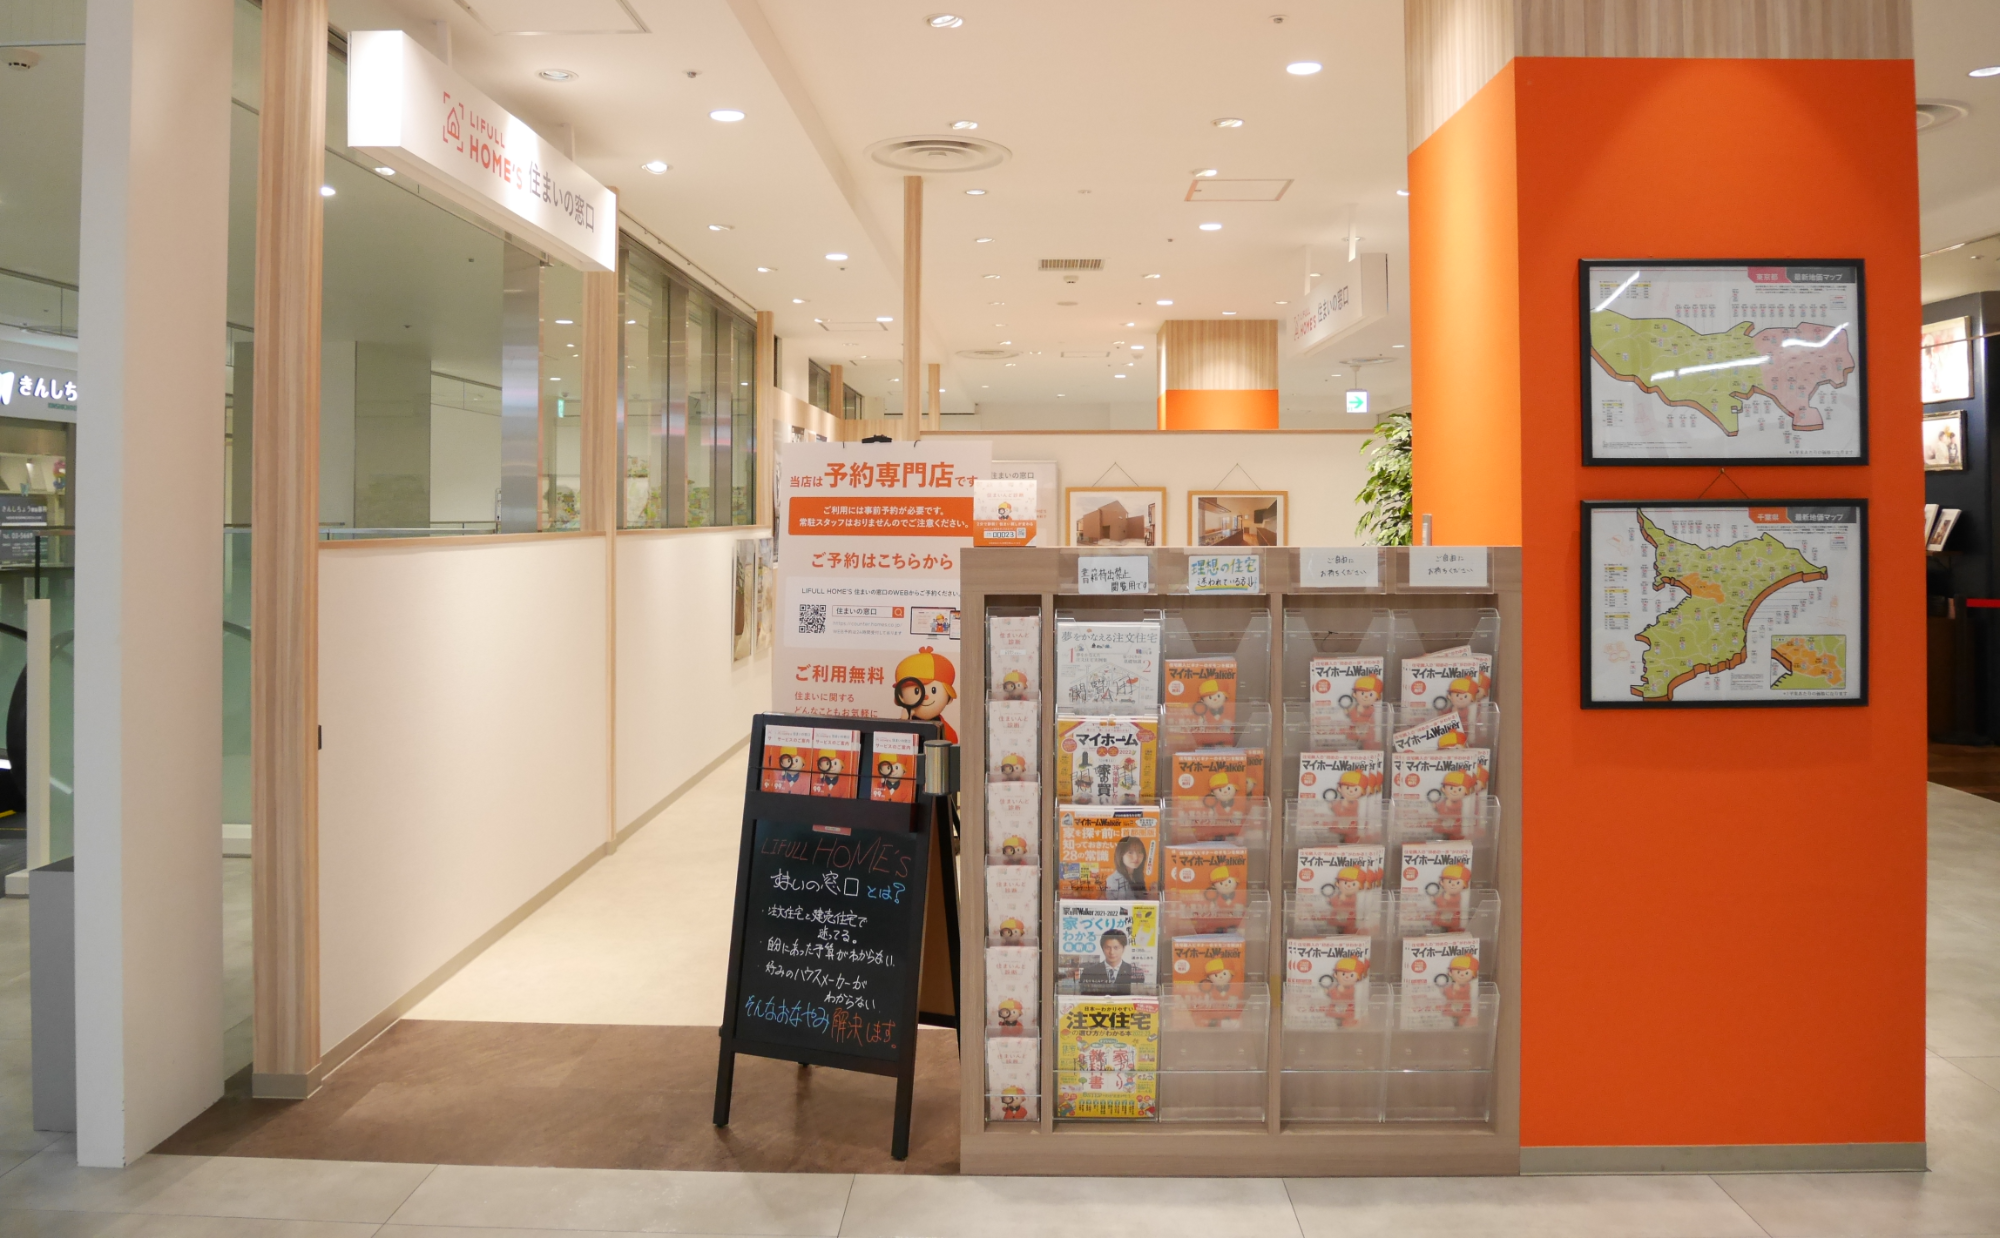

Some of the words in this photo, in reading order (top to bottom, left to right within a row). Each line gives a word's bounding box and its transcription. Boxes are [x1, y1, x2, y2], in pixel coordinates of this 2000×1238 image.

[470, 111, 505, 149] LIFULL
[470, 134, 522, 190] HOME'S
[529, 161, 595, 233] 住まいの窓口
[1756, 273, 1778, 281] 東京都
[1794, 273, 1843, 281] 最新地価マップ
[1318, 285, 1349, 324] 住まいの窓口
[18, 374, 78, 401] きんしち
[823, 506, 945, 517] ご利用には事前予約が必要です。
[1757, 514, 1779, 522] 千葉県
[1795, 513, 1843, 522] 最新地価マップ
[799, 518, 969, 529] 常駐スタッフはおりませんのでご注意ください。
[811, 552, 954, 570] ご予約はこちらから
[1191, 557, 1257, 576] 理想の住宅
[1061, 631, 1158, 643] 夢をかなえる注文住宅
[795, 664, 884, 685] ご利用無料
[1169, 668, 1236, 679] マイホームWalker
[1315, 666, 1382, 677] マイホームWalker
[1411, 668, 1477, 679] マイホームWalker
[794, 691, 855, 703] 住まいに関する
[1076, 733, 1138, 746] マイホーム
[1395, 720, 1460, 750] マイホームWalker
[1179, 761, 1246, 772] マイホームWalker
[1302, 760, 1368, 771] マイホームWalker
[1406, 761, 1472, 772] マイホームWalker
[1063, 828, 1120, 839] 家を探す前に
[1063, 840, 1118, 850] 知っておきたい
[760, 838, 808, 861] LIFULL
[811, 836, 911, 878] HOME'S
[1063, 850, 1109, 861] 28の常識
[1179, 855, 1246, 866] マイホームWalker
[1404, 855, 1470, 865] マイホームWalker
[1300, 856, 1366, 867] マイホームWalker
[1063, 932, 1097, 941] わかる
[1174, 948, 1241, 958] マイホームWalker
[1297, 947, 1364, 958] マイホームWalker
[1411, 946, 1478, 958] マイホームWalker
[765, 960, 867, 990] 好みのハウスメーカーが
[1066, 1011, 1151, 1030] 注文住宅
